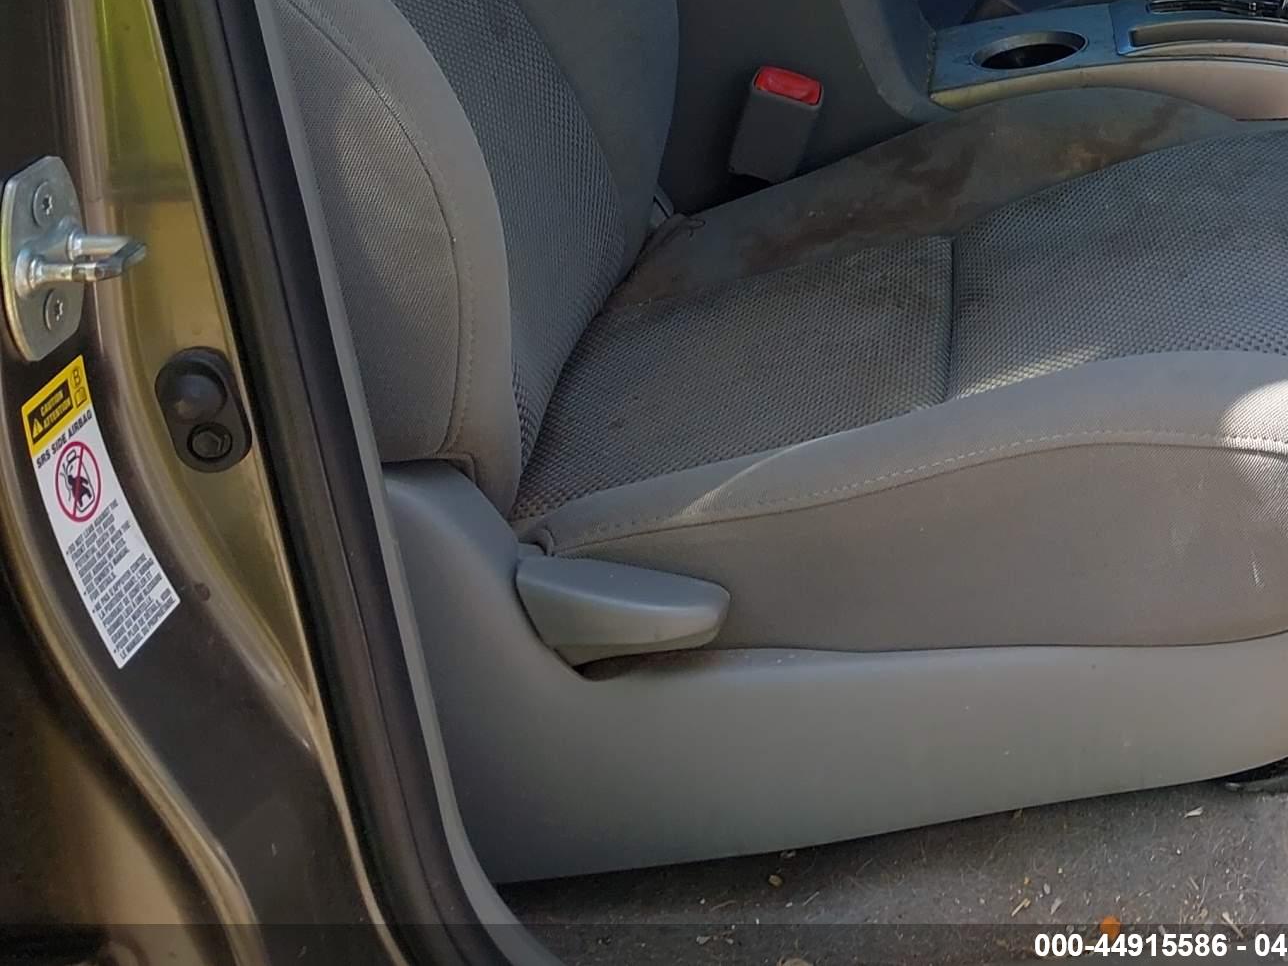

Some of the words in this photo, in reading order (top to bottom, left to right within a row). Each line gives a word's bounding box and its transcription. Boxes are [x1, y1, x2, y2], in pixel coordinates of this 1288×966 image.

[36, 449, 51, 469] SRS
[51, 433, 67, 454] SIDE
[68, 409, 93, 439] AIRBAG
